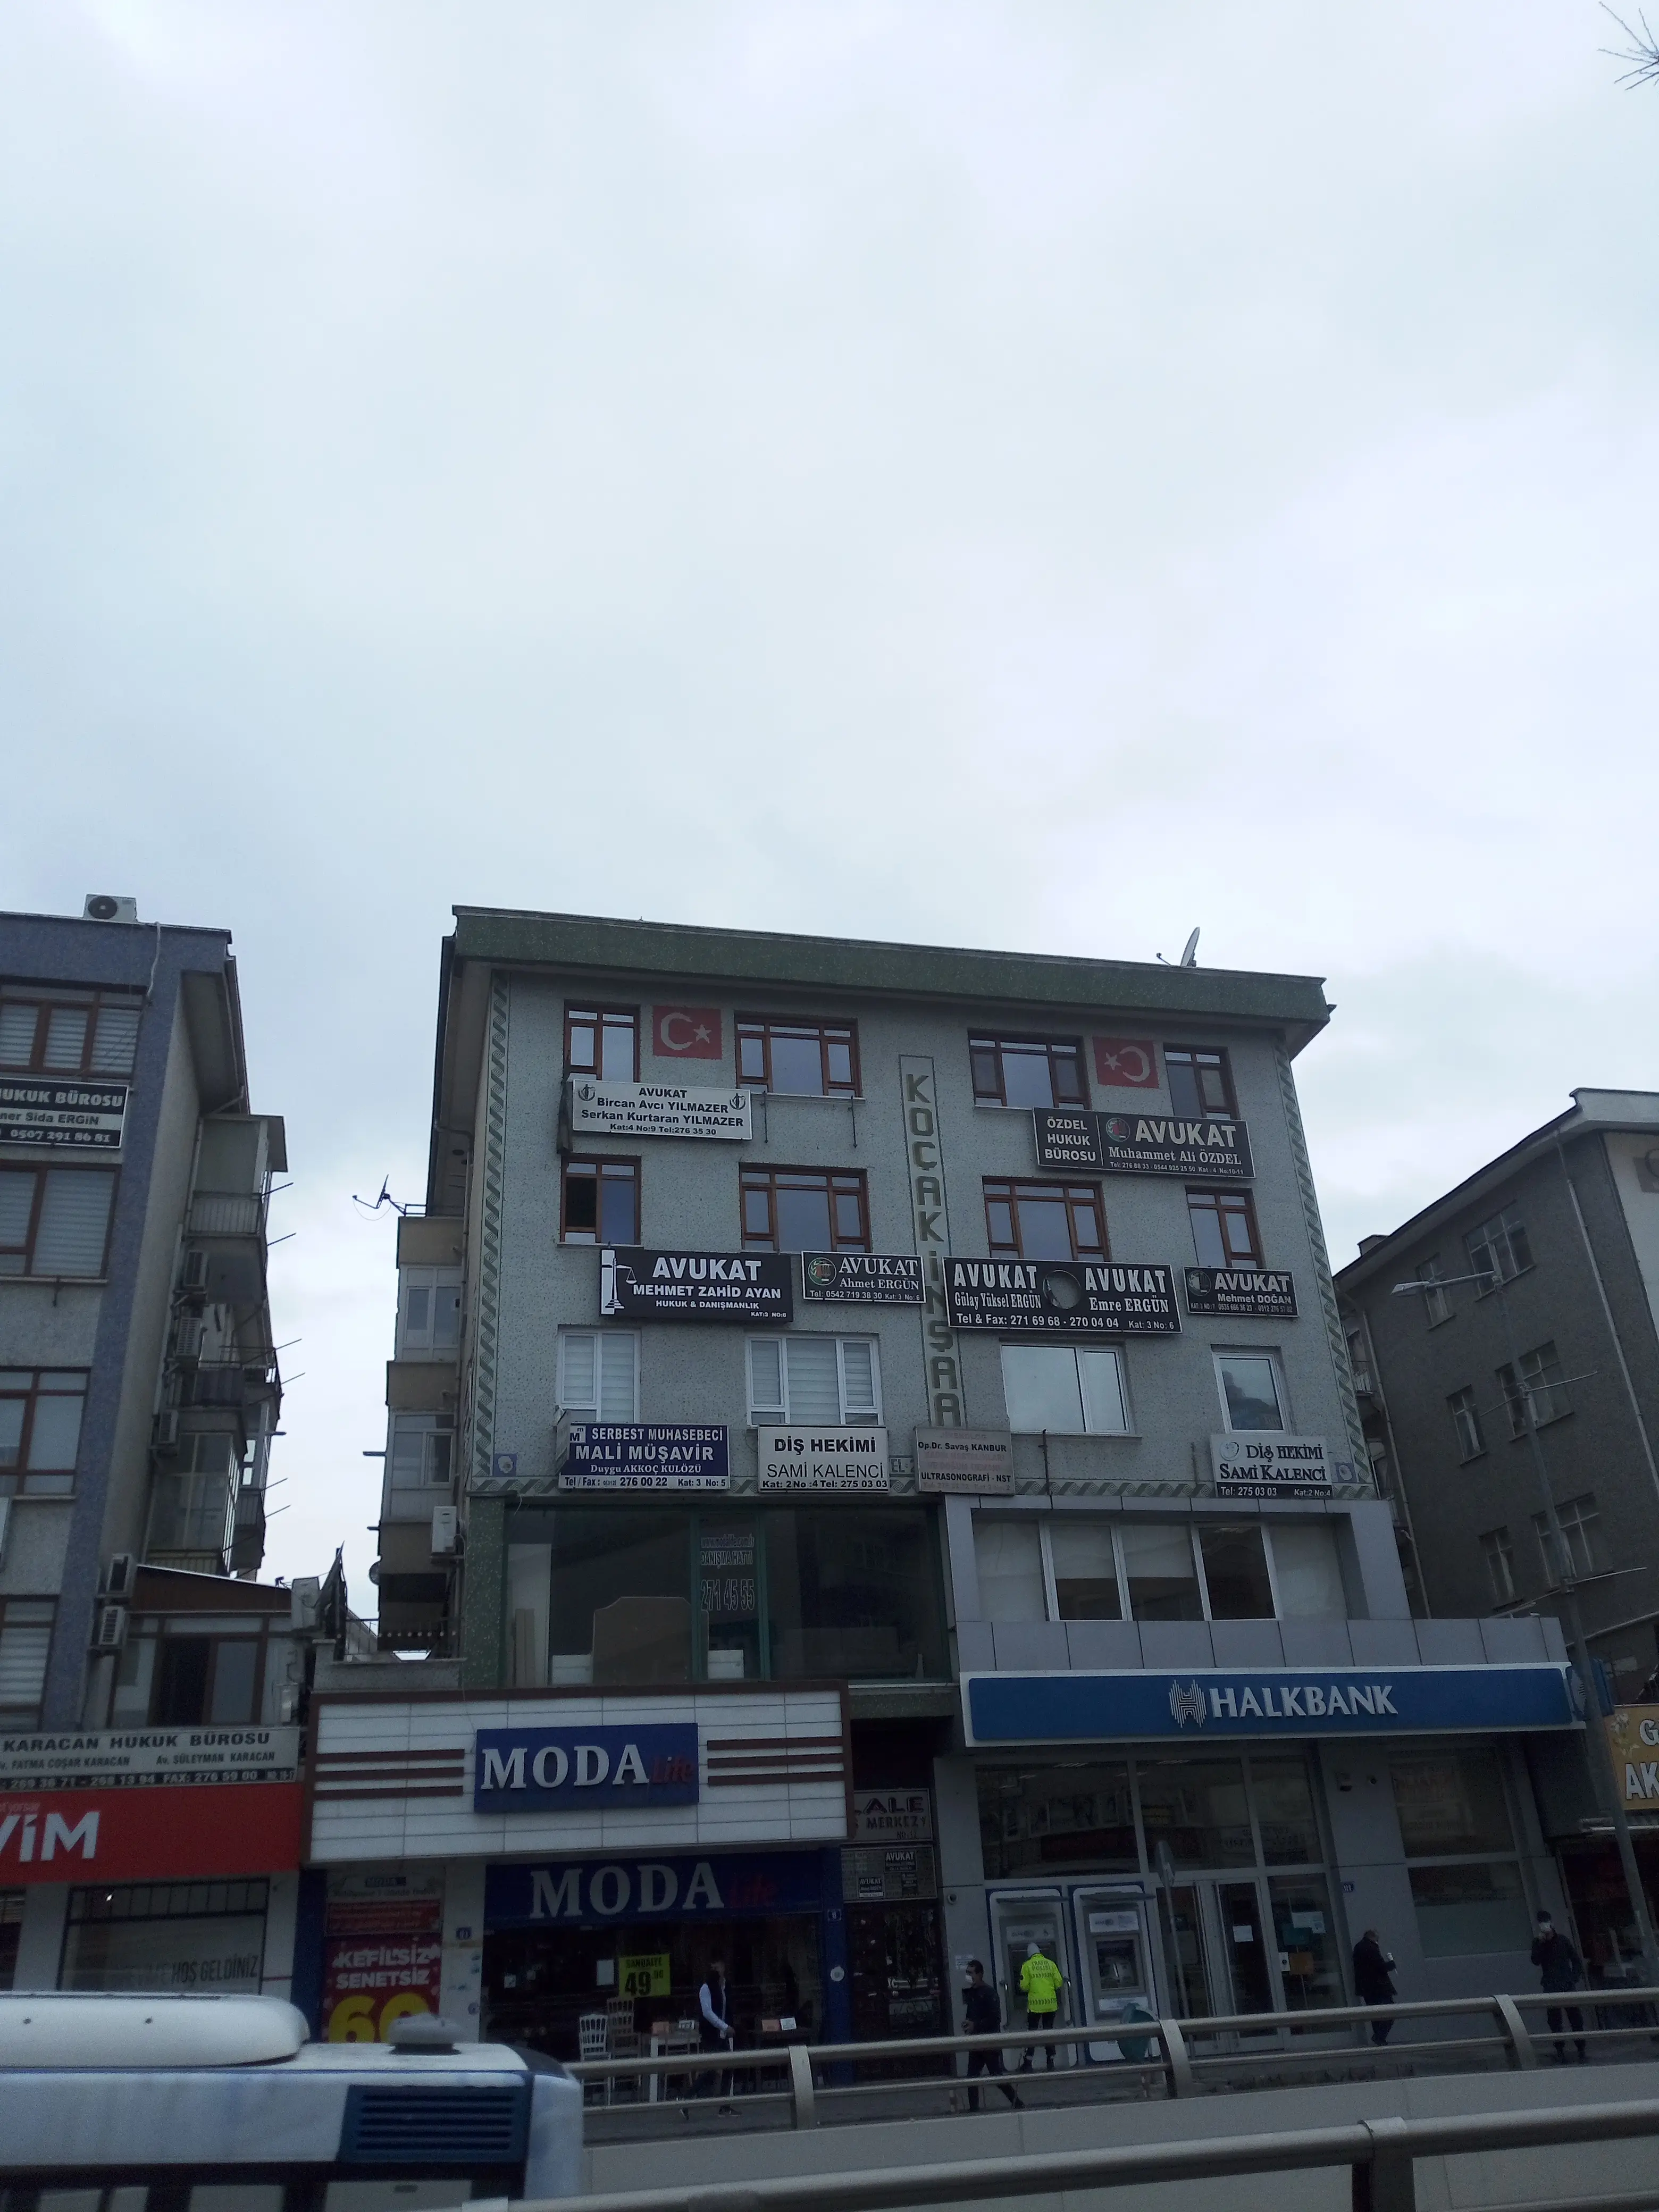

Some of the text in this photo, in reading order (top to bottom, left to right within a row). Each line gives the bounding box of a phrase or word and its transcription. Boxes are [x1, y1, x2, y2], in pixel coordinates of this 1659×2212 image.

[55, 1090, 123, 1107] BÜROSU
[639, 1087, 687, 1099] AVUKAT
[597, 1097, 728, 1113] Bircan Avcı YILMAZER
[26, 1112, 53, 1122] Sida
[581, 1110, 743, 1127] Serkan Kurtaran YILMAZER
[1047, 1117, 1087, 1130] ÖZDEL
[11, 1129, 44, 1140] 0507
[47, 1132, 70, 1141] 291
[1048, 1133, 1091, 1146] HUKUK
[1135, 1120, 1236, 1147] AVUKAT
[906, 1073, 944, 1243] KOÇAK
[1045, 1147, 1096, 1161] BÜROSU
[1109, 1146, 1242, 1164] Muhammet Ali ÖZDEL
[652, 1257, 761, 1281] AVUKAT
[839, 1258, 918, 1276] AVUKAT
[840, 1278, 919, 1290] Ahmet ERGÜN
[954, 1264, 1037, 1289] AVUKAT
[1085, 1268, 1166, 1293] AVUKAT
[1214, 1273, 1289, 1293] AVUKAT
[633, 1285, 781, 1298] MEHMET ZAHİD AYAN
[954, 1290, 1041, 1310] Gülay Yüksel ERGÜN
[1218, 1294, 1291, 1304] Mehmet DOĞAN
[699, 1301, 759, 1310] DANIŞMANLIK
[1089, 1295, 1169, 1313] Emre ERGÜN
[956, 1313, 1167, 1329] Tel Fax: 271 69 68 270 04 04 Kat: No:
[926, 1251, 961, 1427] İNŞAA
[592, 1427, 723, 1442] SERBEST MUHASEBECİ
[576, 1443, 714, 1463] MALİ MÜŞAVİR
[774, 1436, 876, 1455] DİŞ HEKİMİ
[945, 1443, 968, 1452] Savaş
[1246, 1443, 1323, 1462] DİŞ HEKİMİ
[591, 1464, 701, 1476] Duygu AKKOÇ KULÖZÜ
[767, 1462, 808, 1478] SAMİ
[813, 1463, 884, 1478] KALENCİ
[921, 1472, 990, 1481] ULTRASONOGRAFİ
[565, 1477, 576, 1487] Tel
[620, 1477, 638, 1486] 276
[641, 1477, 652, 1486] 00
[656, 1478, 667, 1487] 22
[1221, 1487, 1235, 1496] Tel:
[1238, 1487, 1253, 1496] 275
[1255, 1487, 1264, 1496] 03
[701, 1551, 753, 1569] DANIŞMA HATTI
[701, 1579, 755, 1611] 271 45 55
[1210, 1686, 1398, 1718] HALKBANK
[1640, 1720, 1659, 1746] G
[4, 1731, 271, 1753] KARACAN HUKUK BÜROSU
[230, 1752, 275, 1762] KARACAN
[481, 1744, 649, 1789] MODA
[886, 1852, 914, 1861] AVUKAT
[529, 1863, 725, 1918] MODA
[172, 1962, 197, 1987] HOŞ
[336, 1965, 430, 1989] SENETSİZ
